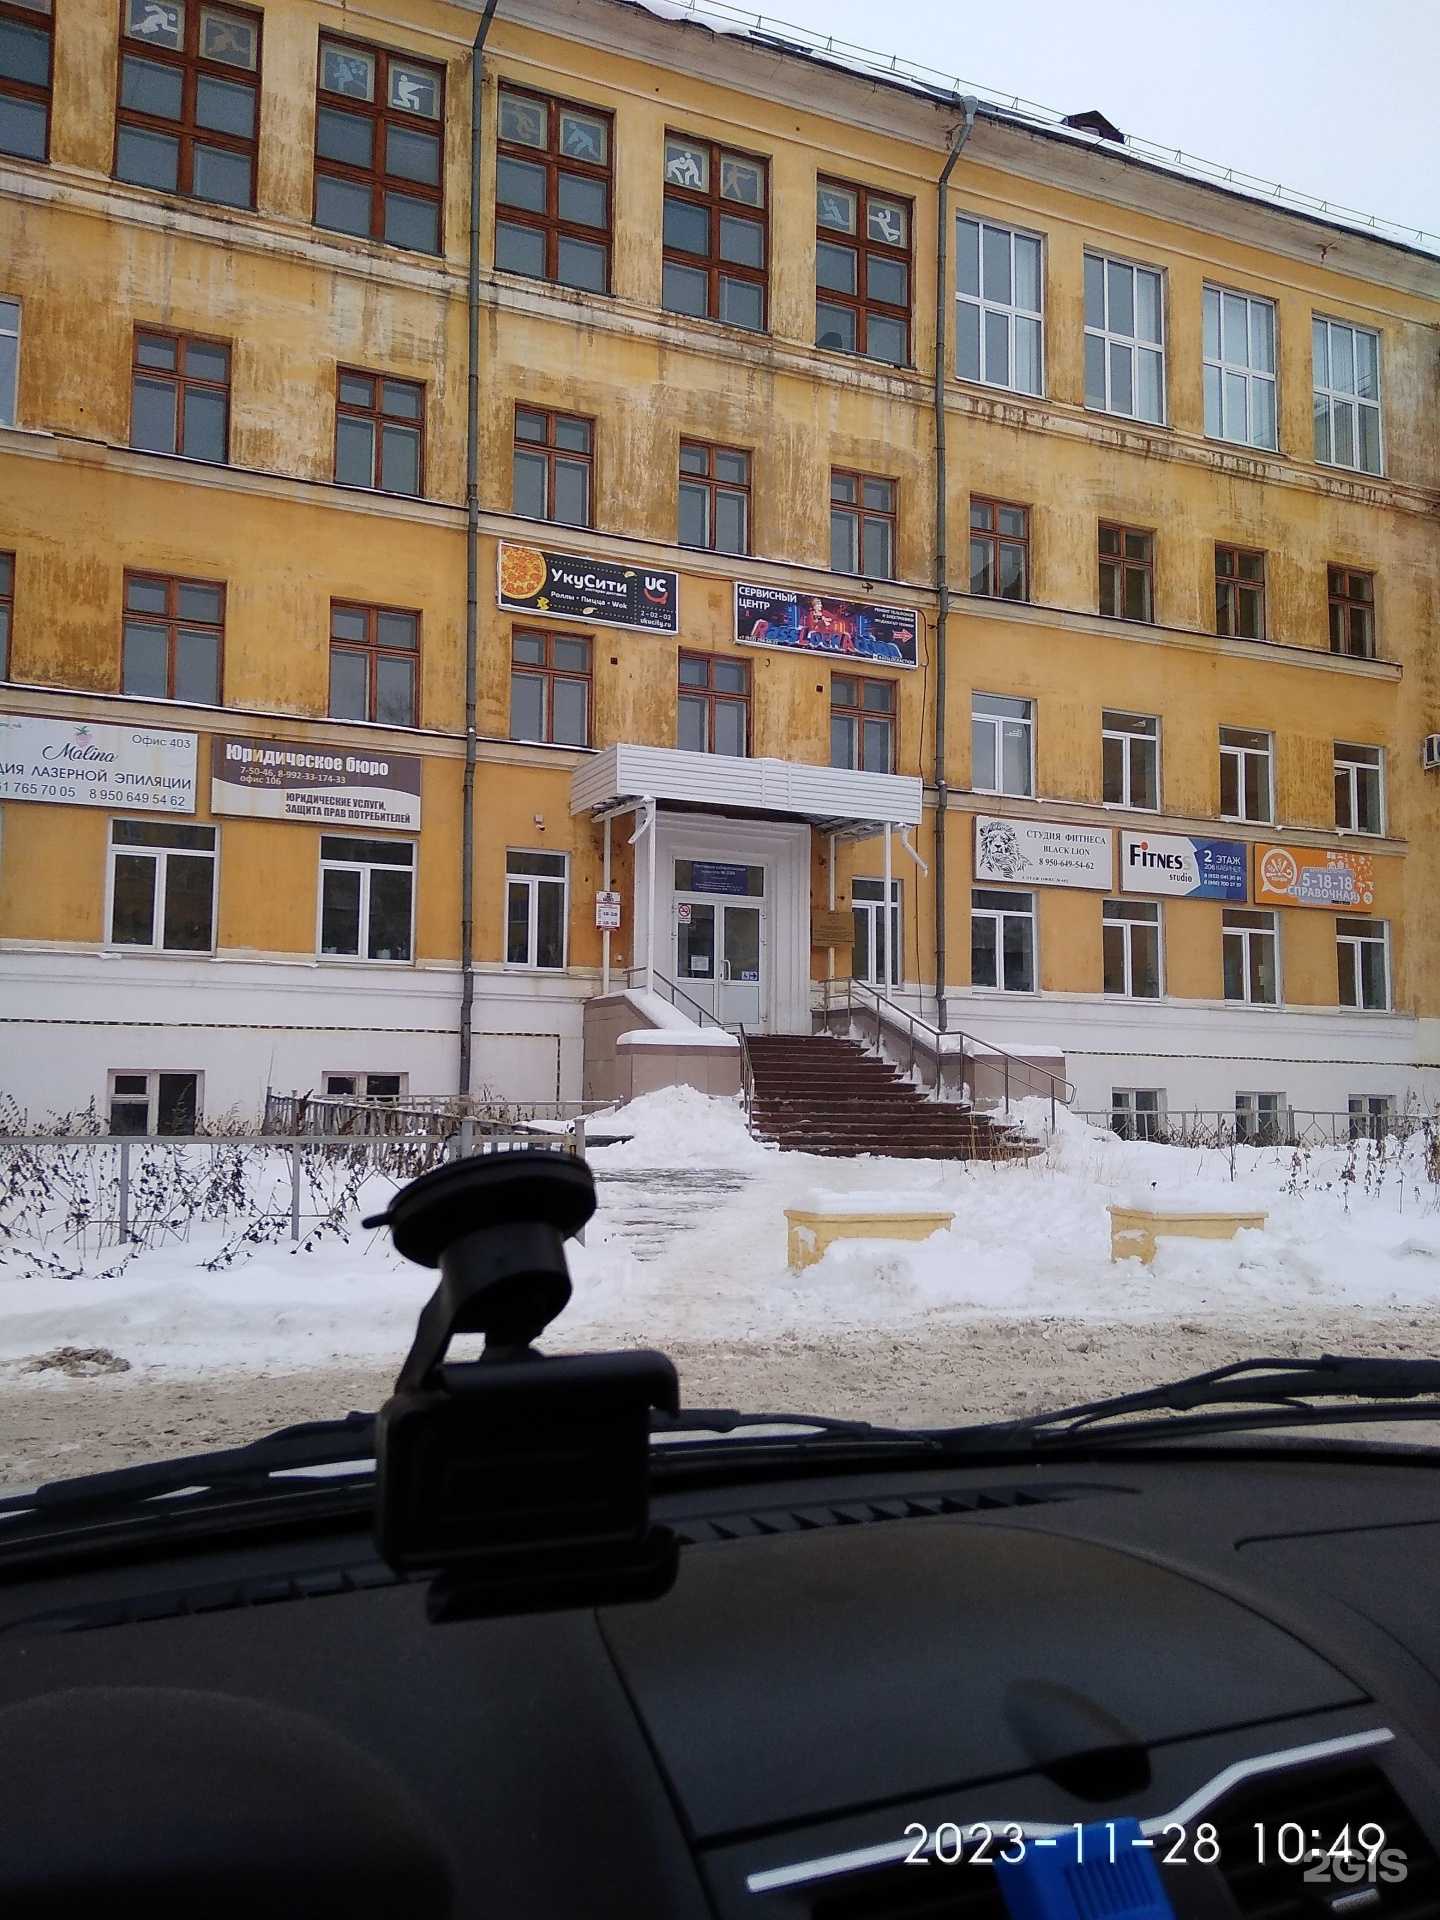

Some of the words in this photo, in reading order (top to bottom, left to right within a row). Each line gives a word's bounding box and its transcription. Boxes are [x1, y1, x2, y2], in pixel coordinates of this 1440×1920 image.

[551, 568, 627, 593] УкуСити
[644, 576, 667, 592] UC
[551, 590, 575, 601] Роллы
[581, 596, 606, 606] Пицца
[612, 600, 628, 609] Wok
[738, 586, 797, 603] СЕРВИСНЫЙ
[738, 598, 770, 611] ЦЕНТР
[640, 618, 672, 628] ukucity.ru
[132, 734, 167, 748] Офис
[169, 739, 191, 749] 403
[42, 743, 119, 763] Malina
[226, 744, 342, 771] Юридическое
[345, 757, 389, 776] бюро
[31, 765, 108, 783] ЛАЗЕРНОЙ
[115, 773, 191, 790] ЭПИЛЯЦИИ
[239, 775, 264, 786] офис
[266, 776, 281, 786] 106
[14, 782, 37, 794] 765
[41, 784, 56, 796] 70
[60, 786, 75, 798] 05
[90, 788, 96, 799] 8
[100, 789, 123, 801] 950
[126, 791, 149, 803] 649
[152, 794, 166, 805] 54
[170, 796, 185, 806] 62
[286, 792, 351, 806] ЮРИДИЧЕСКИЕ
[352, 798, 386, 811] УСЛУГИ,
[285, 803, 322, 816] ЗАЩИТА
[324, 806, 346, 818] ПРАВ
[348, 809, 410, 824] ПОТРЕБИТЕЛЕЙ
[1026, 830, 1061, 841] СТУДИЯ
[1065, 834, 1106, 845] ФИТНЕСА
[1043, 845, 1071, 855] BLACK
[1071, 847, 1091, 856] LION
[1203, 850, 1212, 863] 2
[1216, 854, 1240, 865] ЭТАЖ
[1045, 859, 1094, 870] 950-649-54-62
[1169, 872, 1193, 883] studio
[1302, 872, 1353, 891] 5-18-18
[1288, 886, 1361, 903] СПРАВОЧНАЯ
